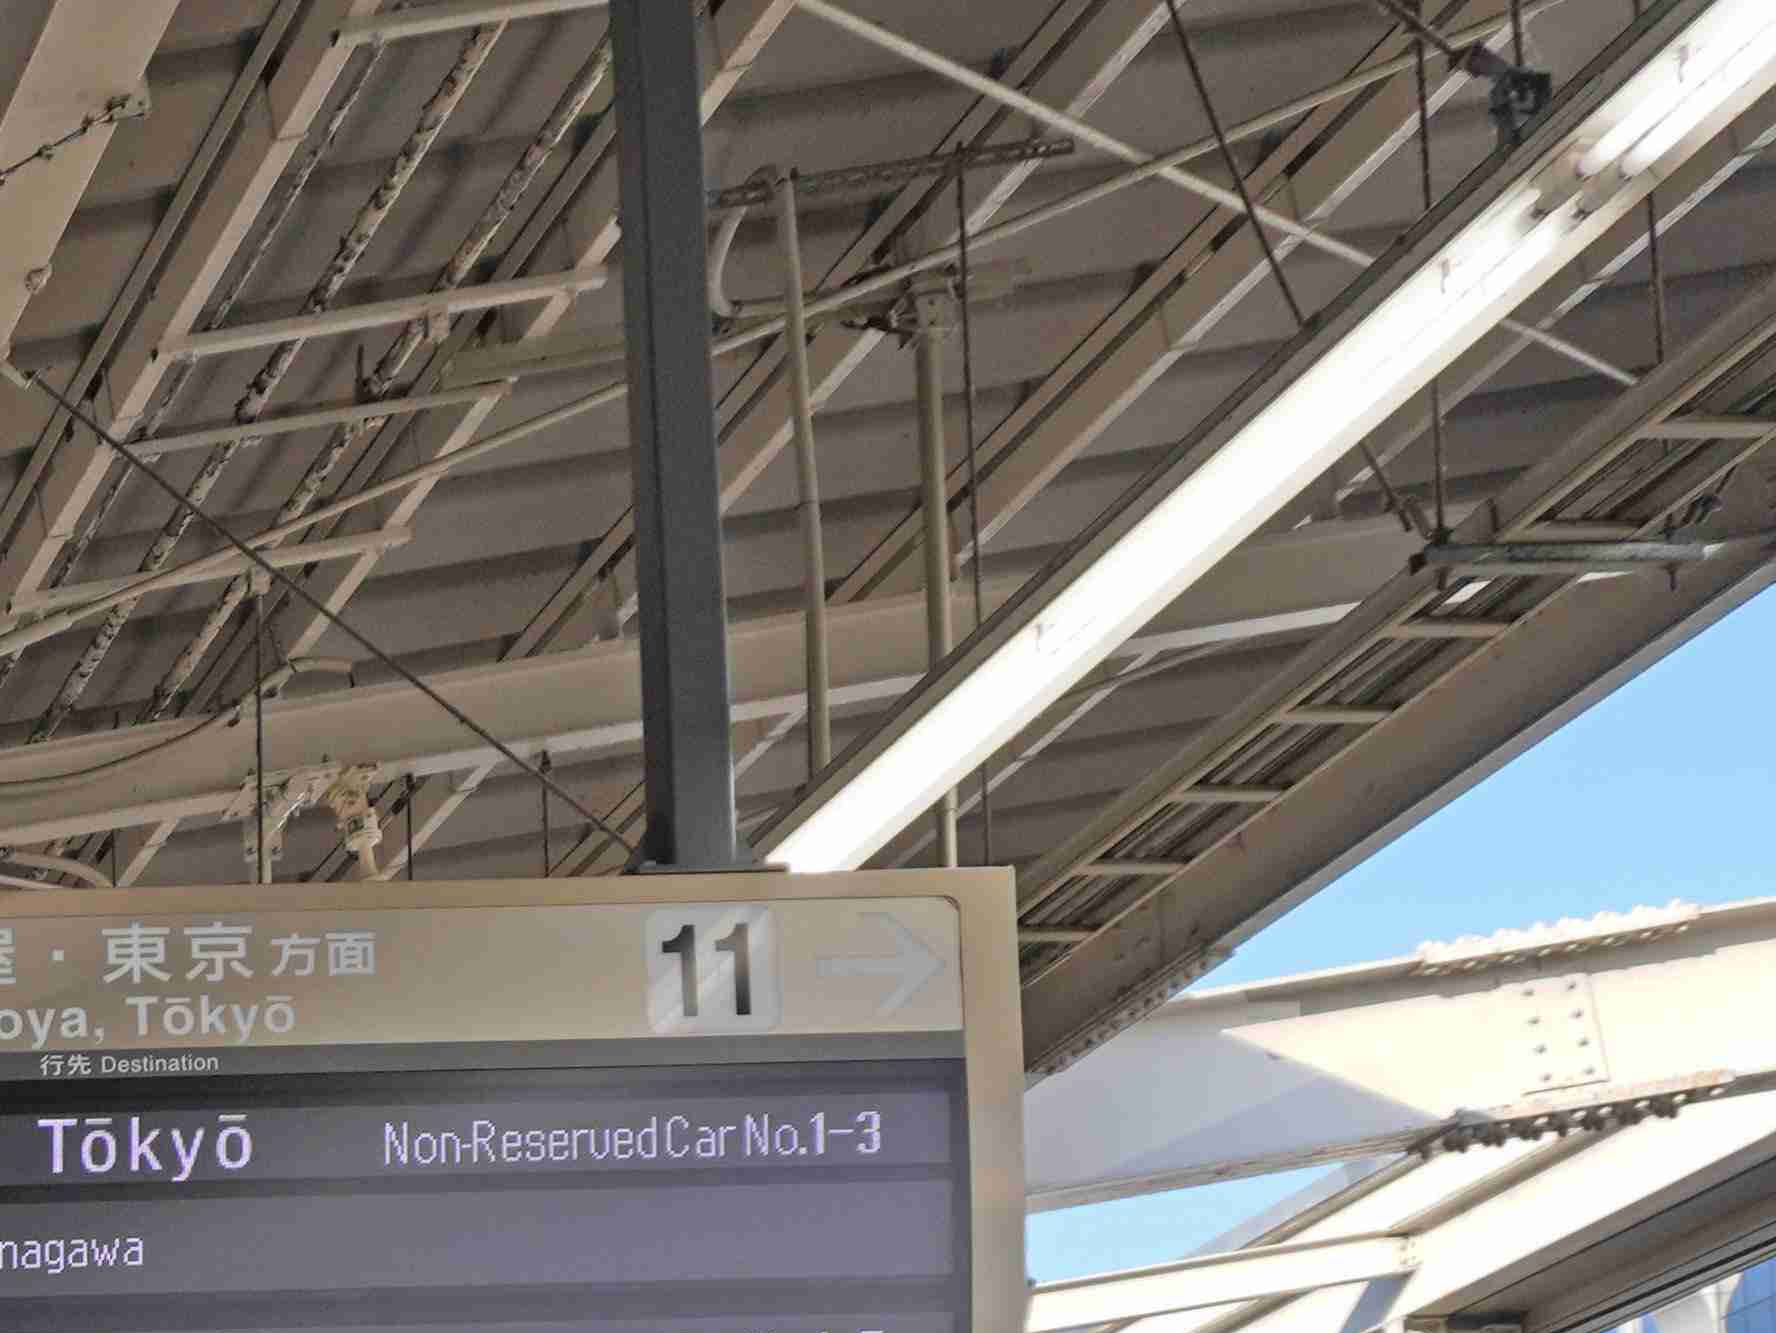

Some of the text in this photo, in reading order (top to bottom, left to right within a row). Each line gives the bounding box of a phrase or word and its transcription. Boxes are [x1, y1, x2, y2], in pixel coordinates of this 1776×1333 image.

[660, 922, 752, 1018] 11
[126, 994, 295, 1045] Tōkyō
[40, 1053, 219, 1077] 行先 Destination
[39, 1115, 252, 1182] Tōkyō
[666, 1114, 736, 1160] Car
